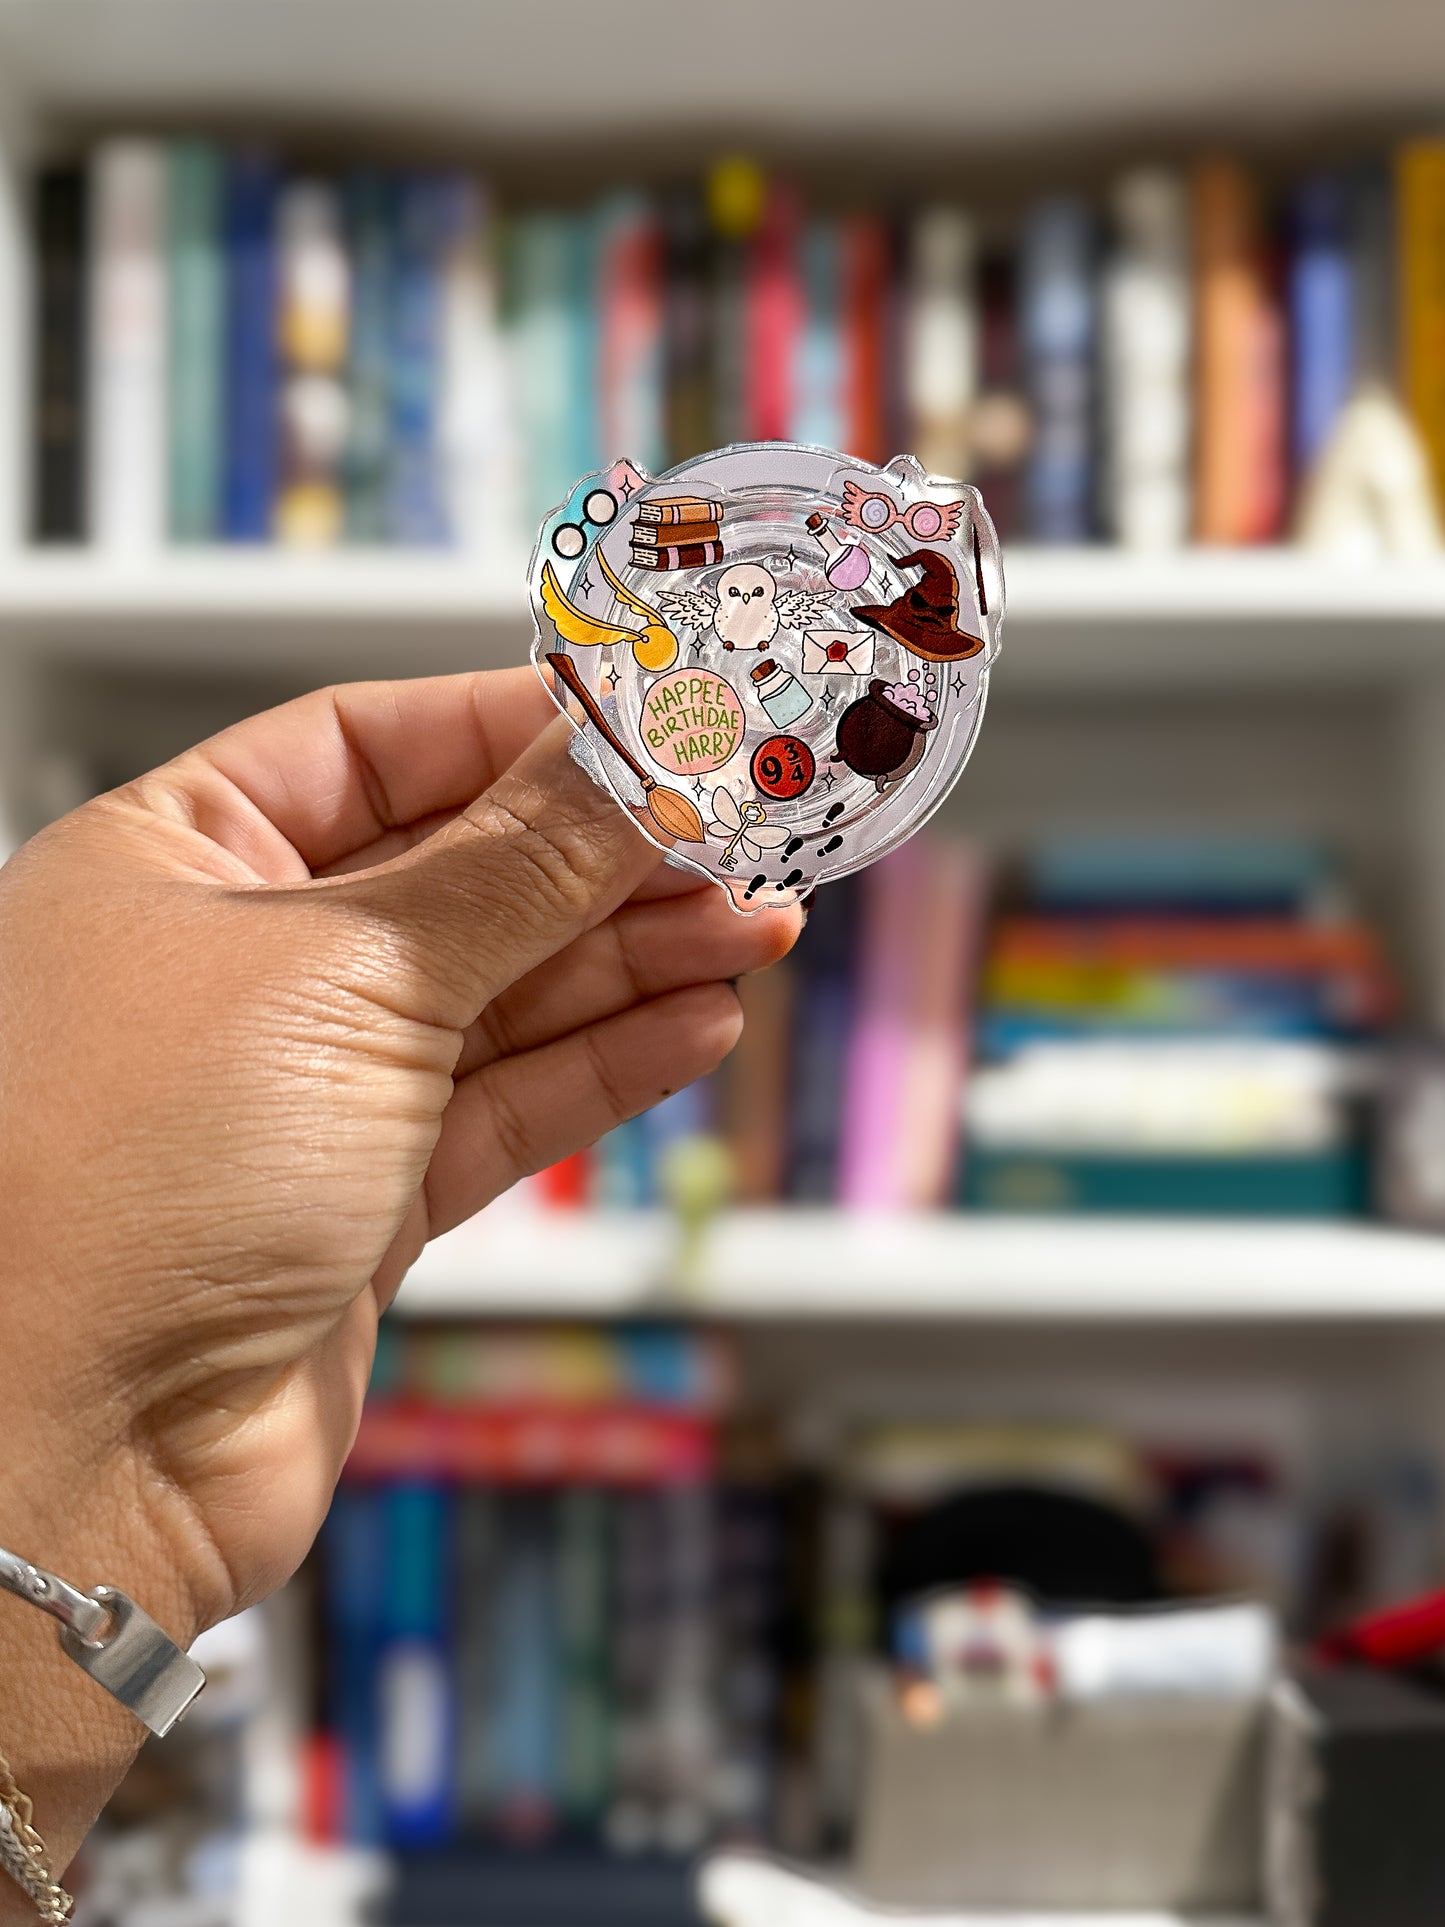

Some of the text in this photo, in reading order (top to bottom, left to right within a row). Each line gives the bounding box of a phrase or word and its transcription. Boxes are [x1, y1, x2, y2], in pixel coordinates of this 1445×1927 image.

[647, 678, 728, 721] HAPPEE
[646, 706, 740, 749] BIRTHDAE
[673, 731, 737, 766] HARRY
